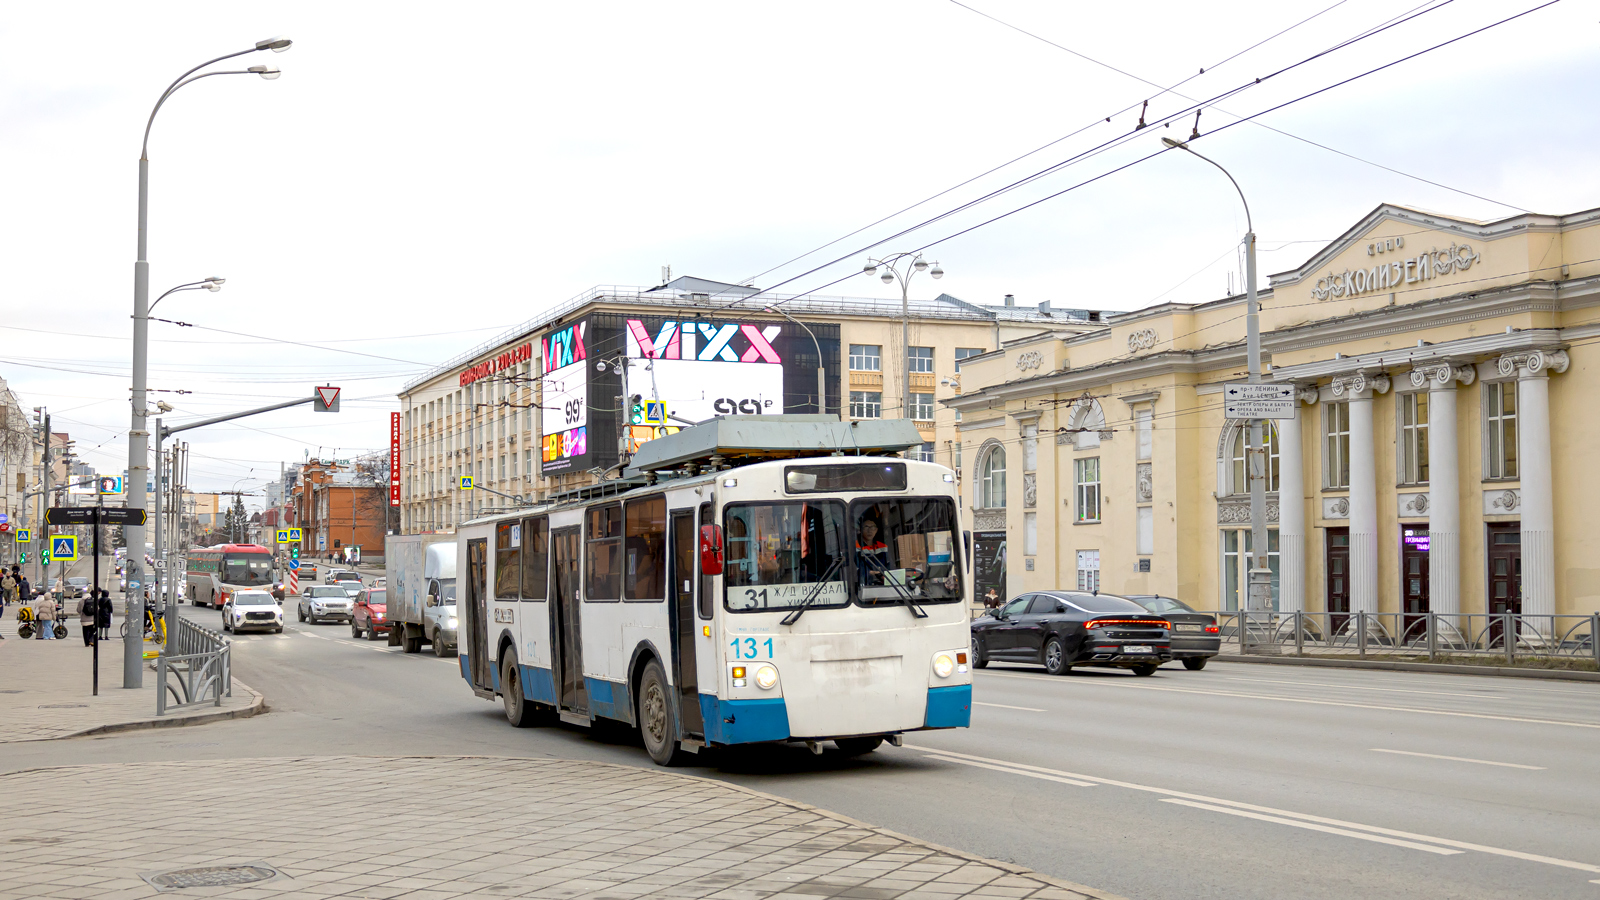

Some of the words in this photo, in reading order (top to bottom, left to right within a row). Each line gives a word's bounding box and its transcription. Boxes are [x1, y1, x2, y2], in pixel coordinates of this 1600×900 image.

[1345, 251, 1431, 297] КОЛИЗЕЙ
[744, 588, 768, 609] 31
[730, 638, 774, 659] 131
